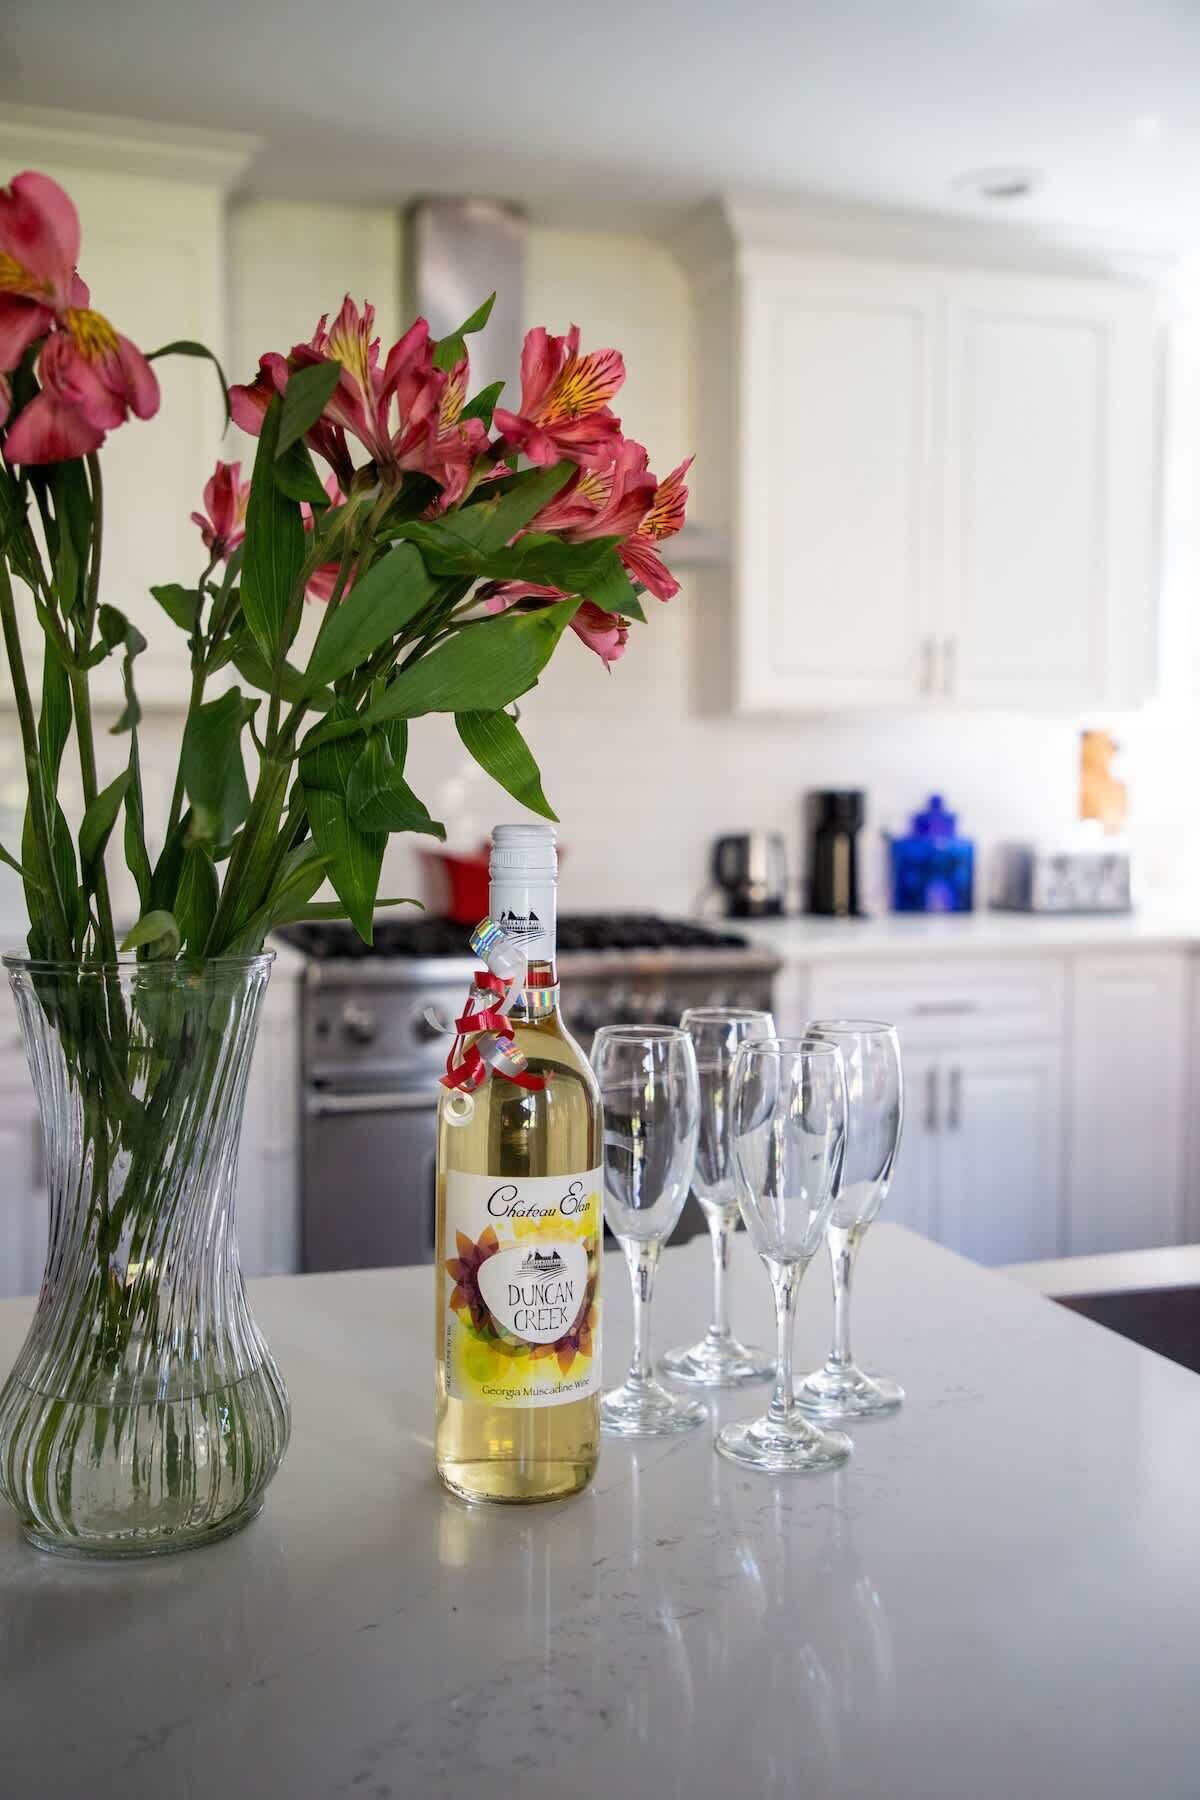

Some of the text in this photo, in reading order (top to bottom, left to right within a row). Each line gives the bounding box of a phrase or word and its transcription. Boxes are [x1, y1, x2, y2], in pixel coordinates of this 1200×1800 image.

[508, 1280, 574, 1306] DUNCAN
[513, 1306, 568, 1331] CREEK
[481, 1384, 521, 1400] Georgia
[523, 1381, 574, 1396] Muscadine
